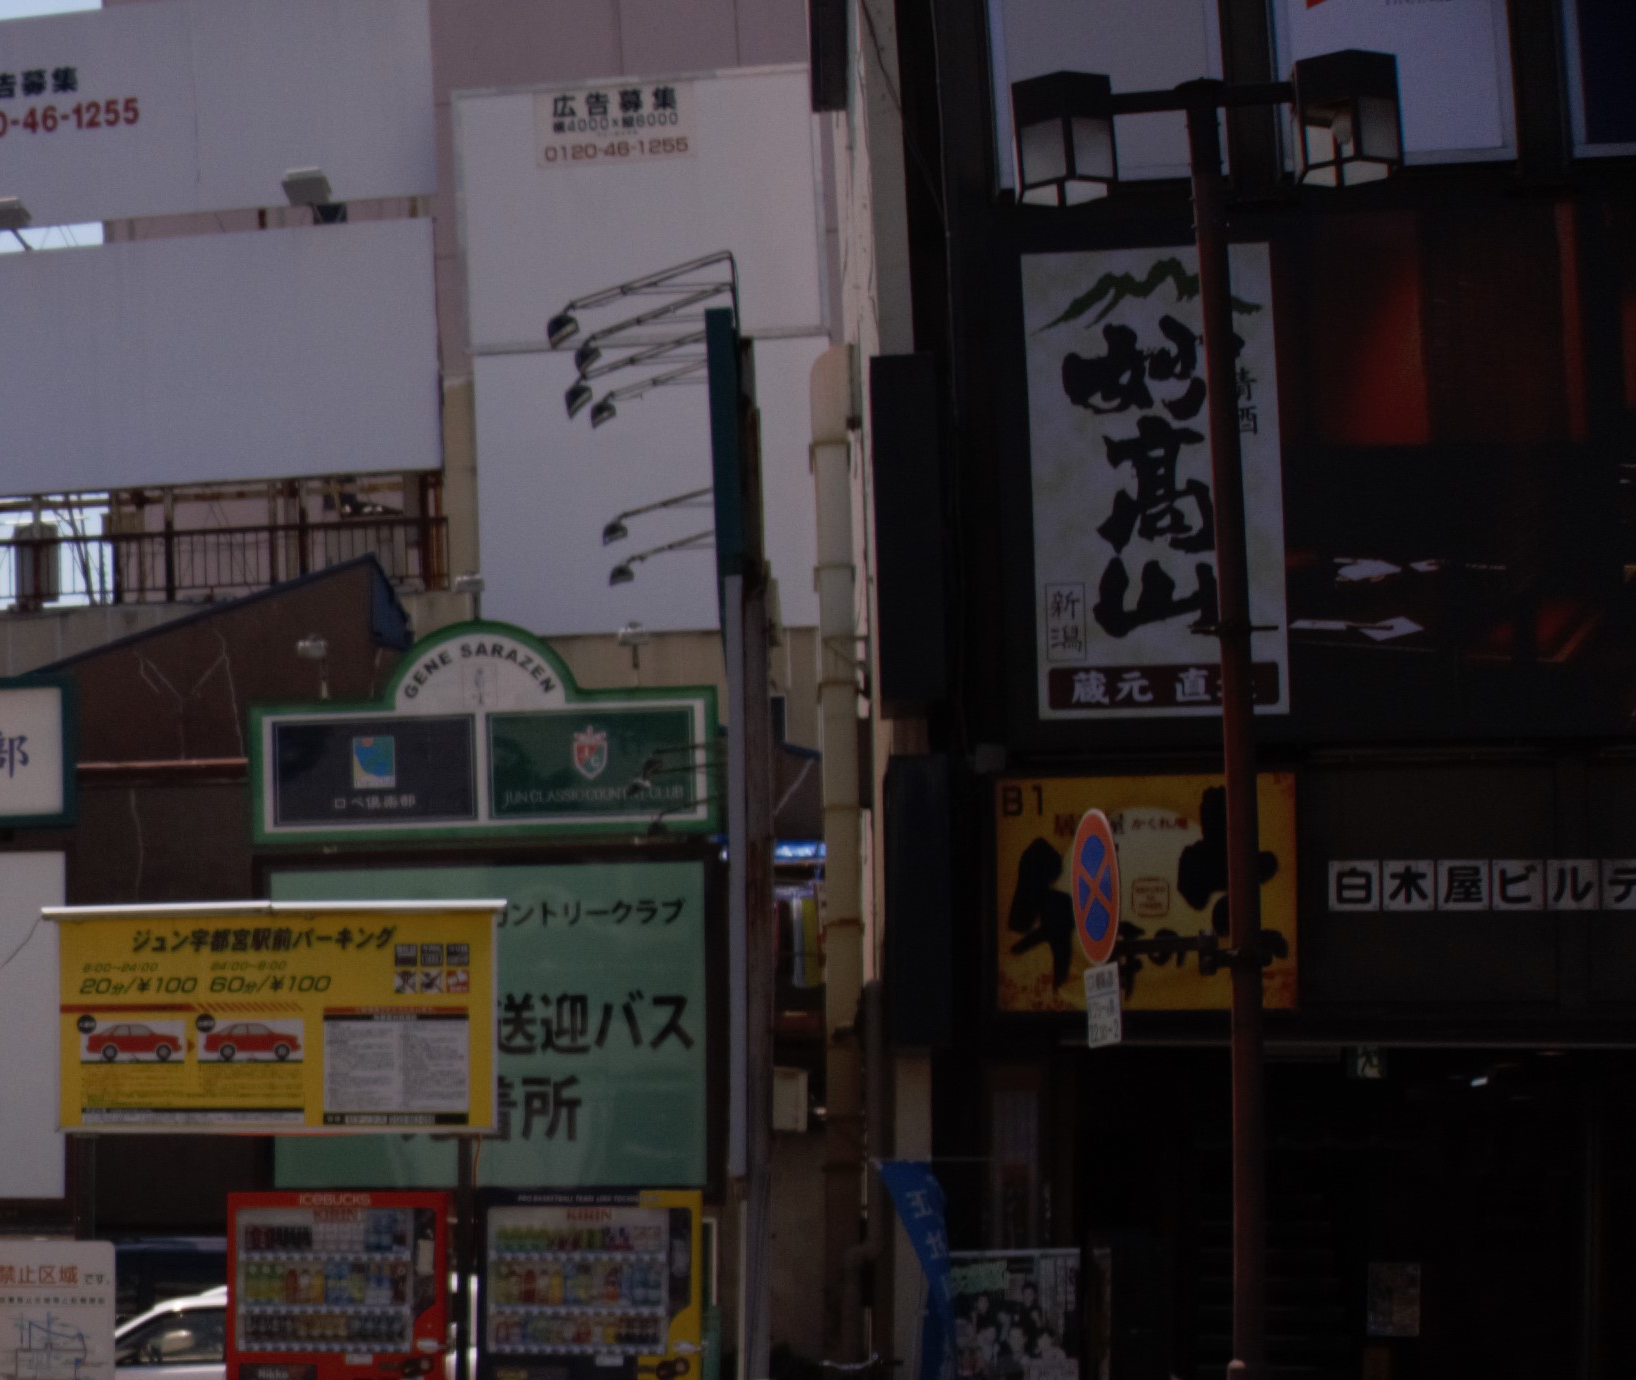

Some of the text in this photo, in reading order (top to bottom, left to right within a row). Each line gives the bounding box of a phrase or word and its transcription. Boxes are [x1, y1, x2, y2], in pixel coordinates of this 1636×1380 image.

[553, 87, 677, 117] 広告募集
[545, 137, 688, 162] 0120-46-1255
[404, 643, 556, 699] GENE SARAZEN
[1072, 669, 1154, 706] 蔵元
[1002, 785, 1044, 817] B1
[132, 926, 397, 954] ジュン宇都宮駅前パーキング
